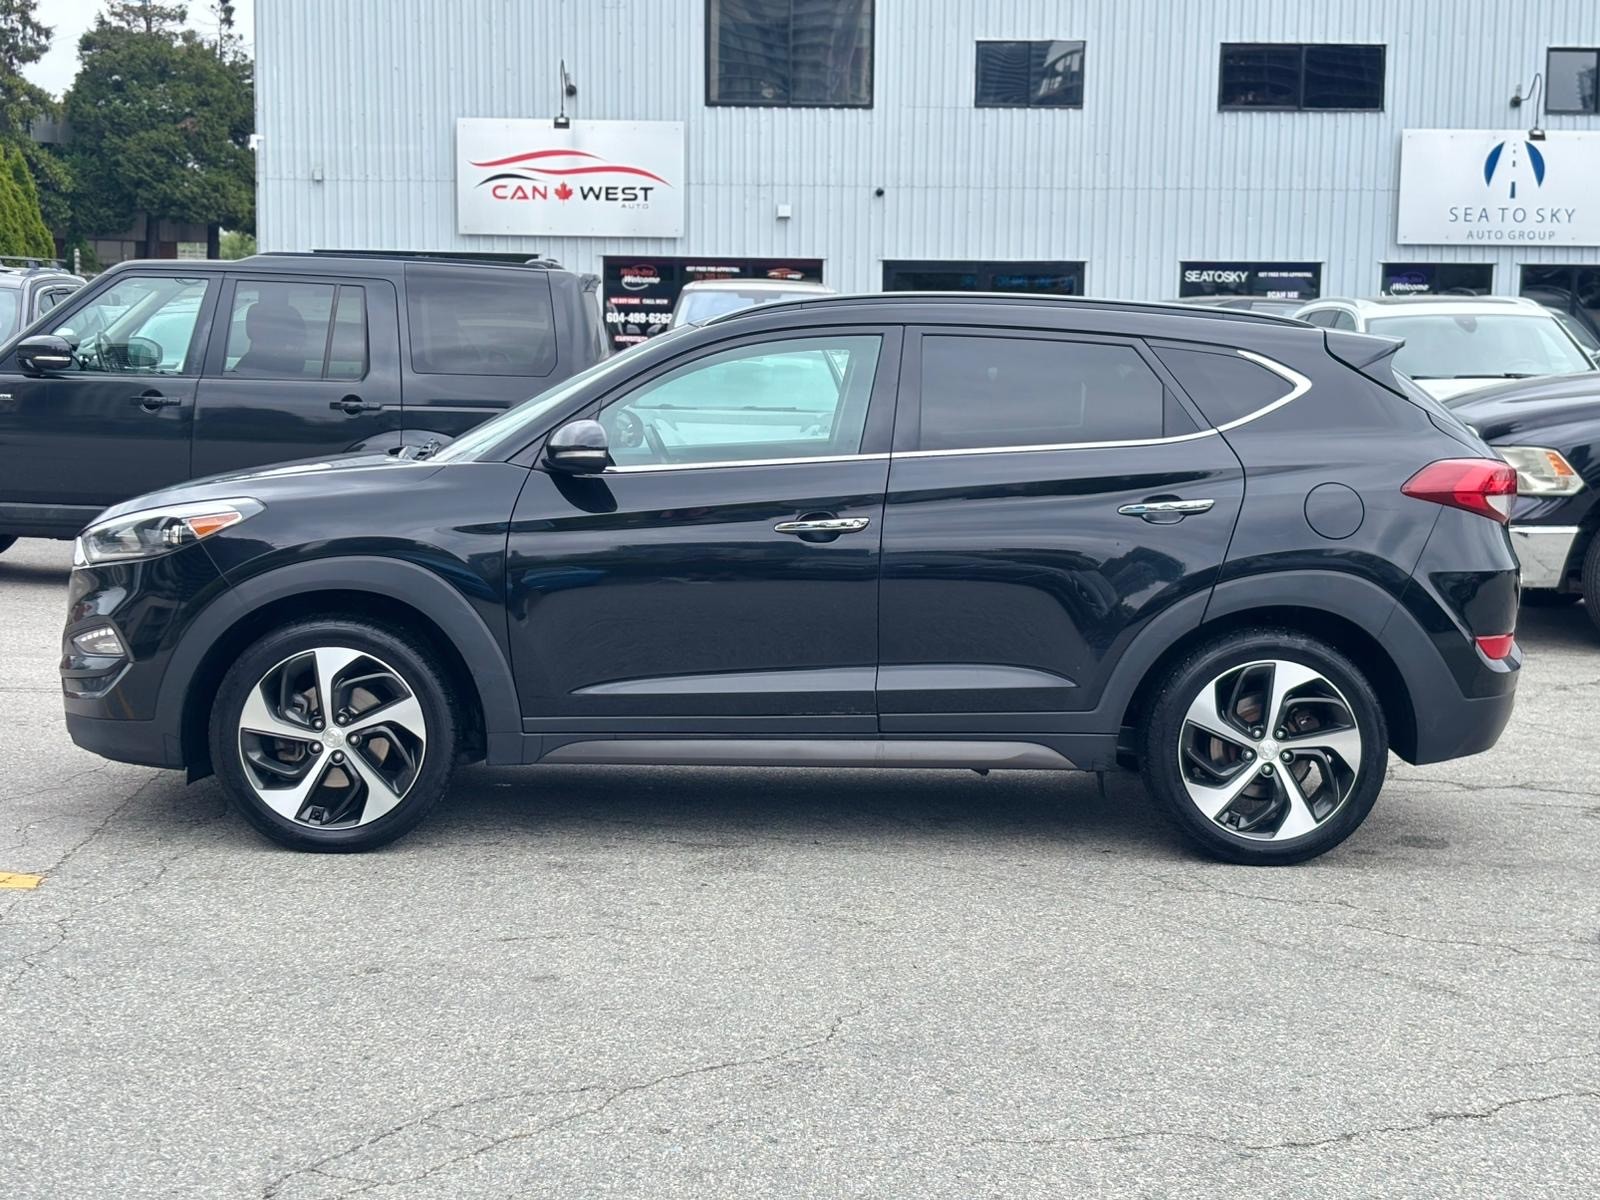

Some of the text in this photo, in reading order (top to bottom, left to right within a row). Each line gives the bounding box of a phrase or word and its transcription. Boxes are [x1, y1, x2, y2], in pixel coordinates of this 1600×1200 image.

[492, 185, 654, 202] CAN WEST
[1449, 207, 1576, 224] SEA TO SKY
[1466, 230, 1556, 240] AUTO GROUP
[624, 275, 661, 284] Welcome
[1184, 270, 1249, 282] SEATOSKY
[1392, 282, 1429, 291] Welcome
[1267, 290, 1299, 299] SCAN ME
